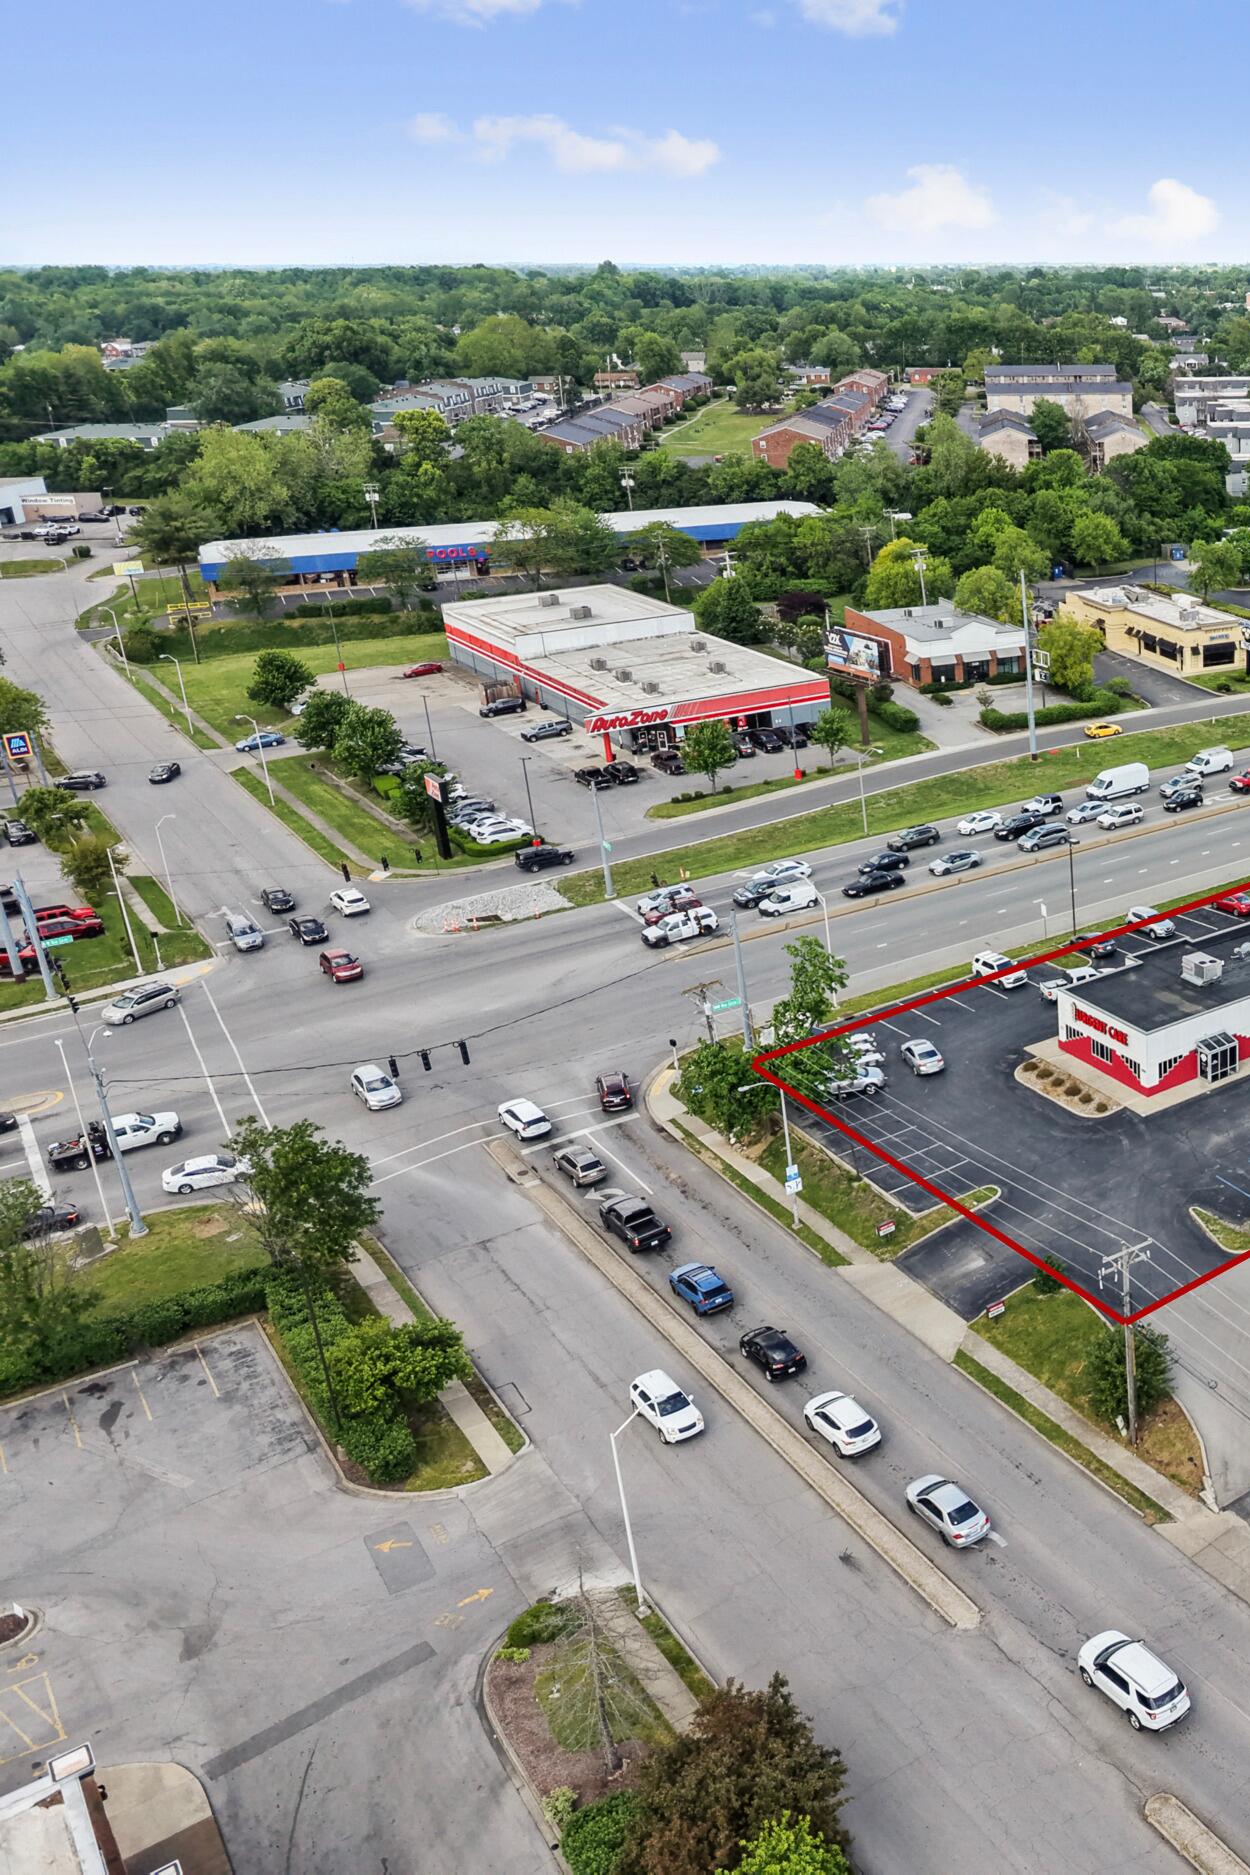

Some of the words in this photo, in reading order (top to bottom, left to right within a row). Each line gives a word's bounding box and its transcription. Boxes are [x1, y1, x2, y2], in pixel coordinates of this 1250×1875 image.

[591, 709, 668, 733] AutoZone
[1075, 1008, 1108, 1035] URGENT
[1108, 1026, 1129, 1046] CARE
